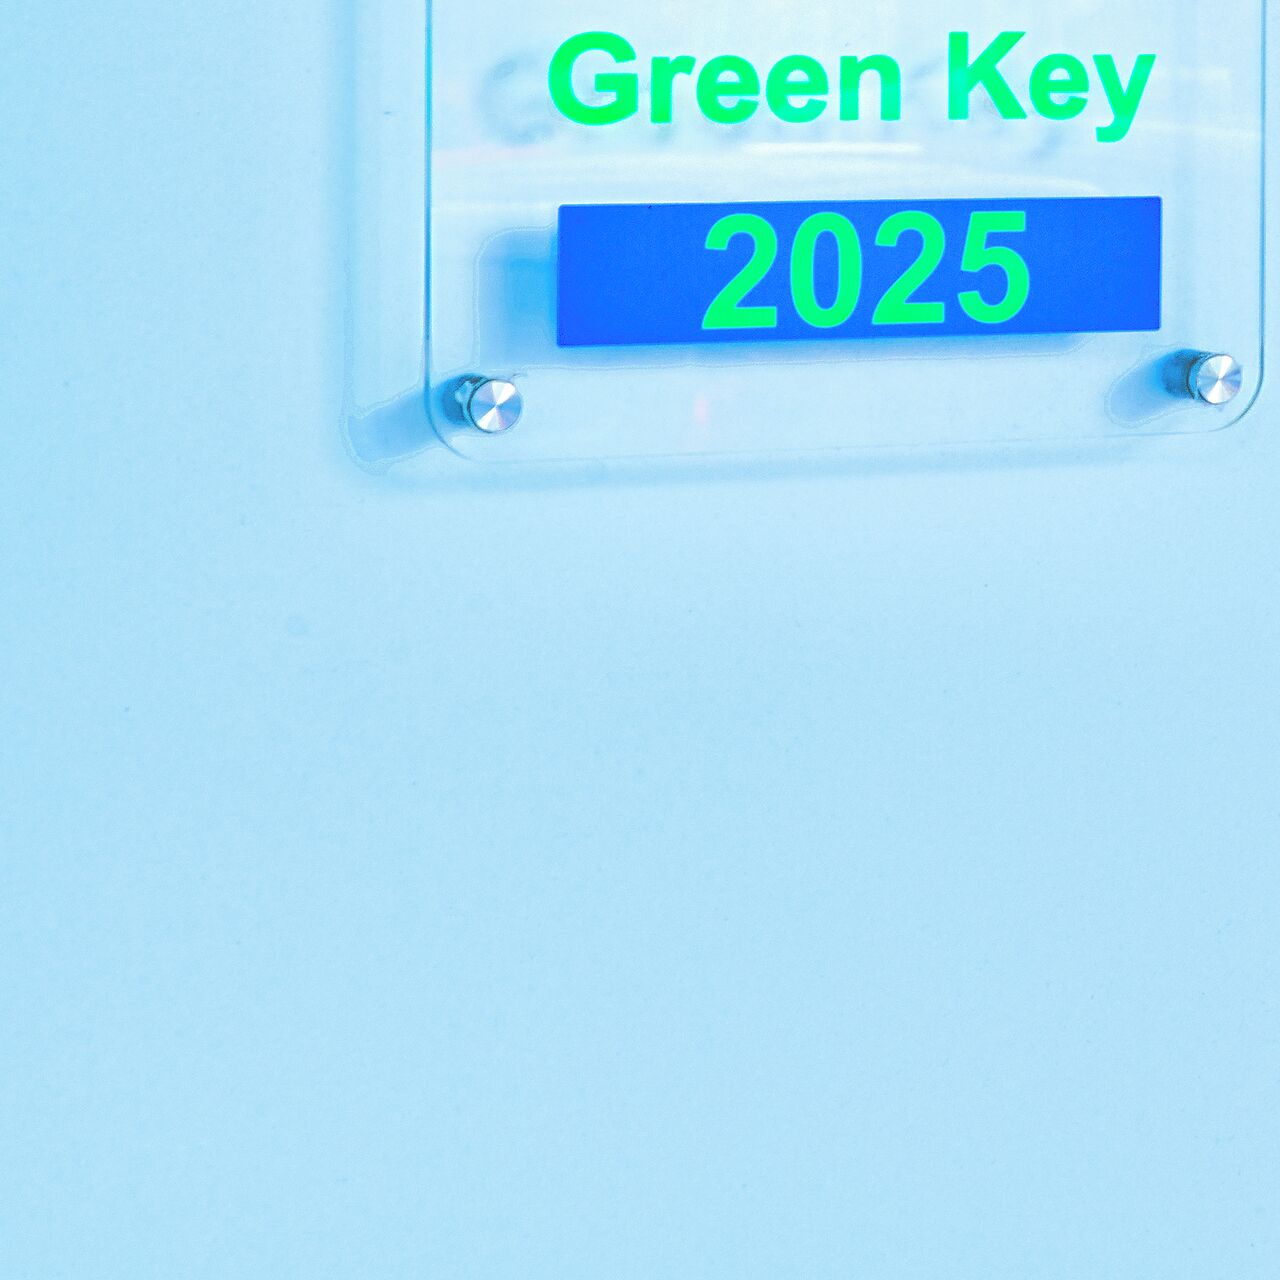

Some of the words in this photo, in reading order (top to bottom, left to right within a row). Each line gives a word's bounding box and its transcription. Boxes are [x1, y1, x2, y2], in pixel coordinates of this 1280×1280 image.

[547, 31, 902, 126] Green
[947, 31, 1157, 143] Key
[701, 209, 1031, 330] 2025
